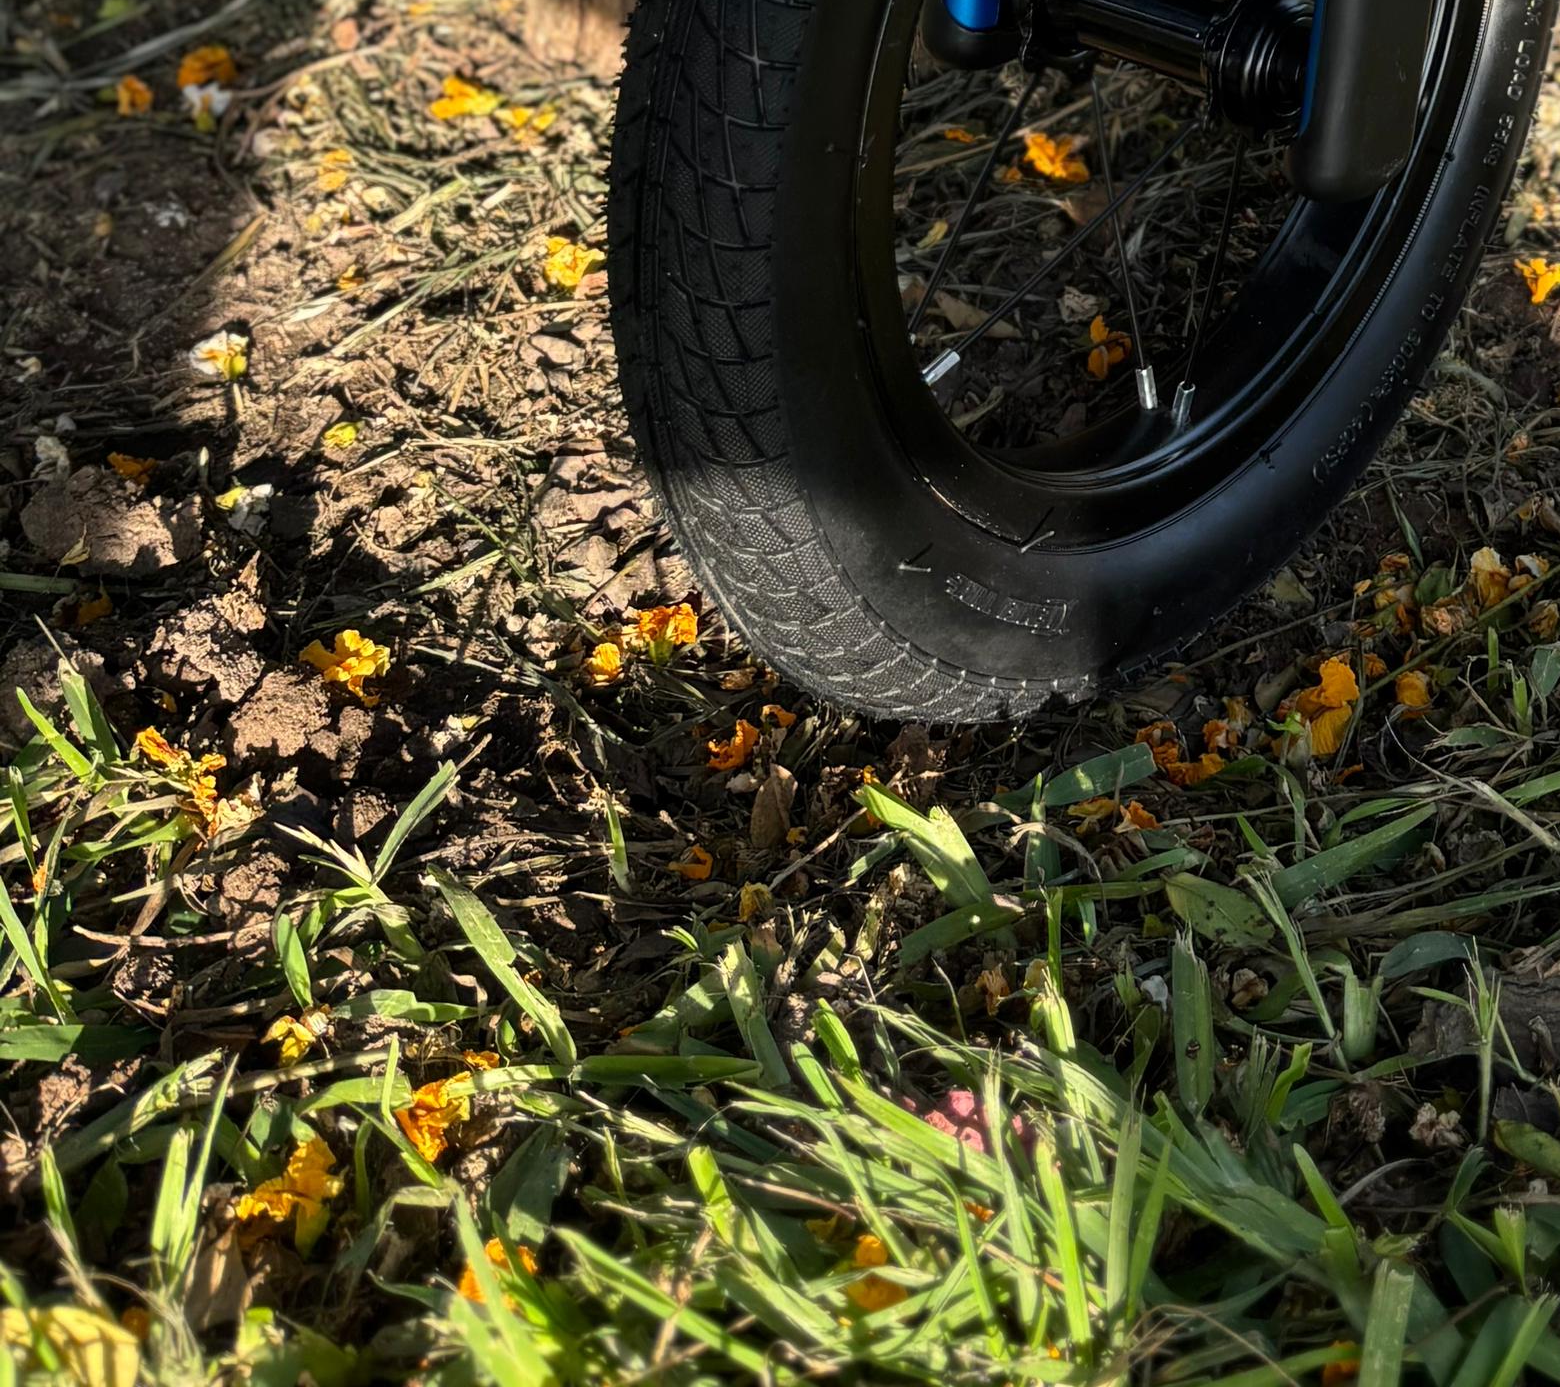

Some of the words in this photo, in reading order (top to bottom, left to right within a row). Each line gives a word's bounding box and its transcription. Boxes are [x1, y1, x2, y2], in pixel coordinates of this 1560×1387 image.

[1506, 38, 1536, 102] LOAD
[1441, 184, 1491, 283] INFLATE
[1421, 291, 1445, 321] TO
